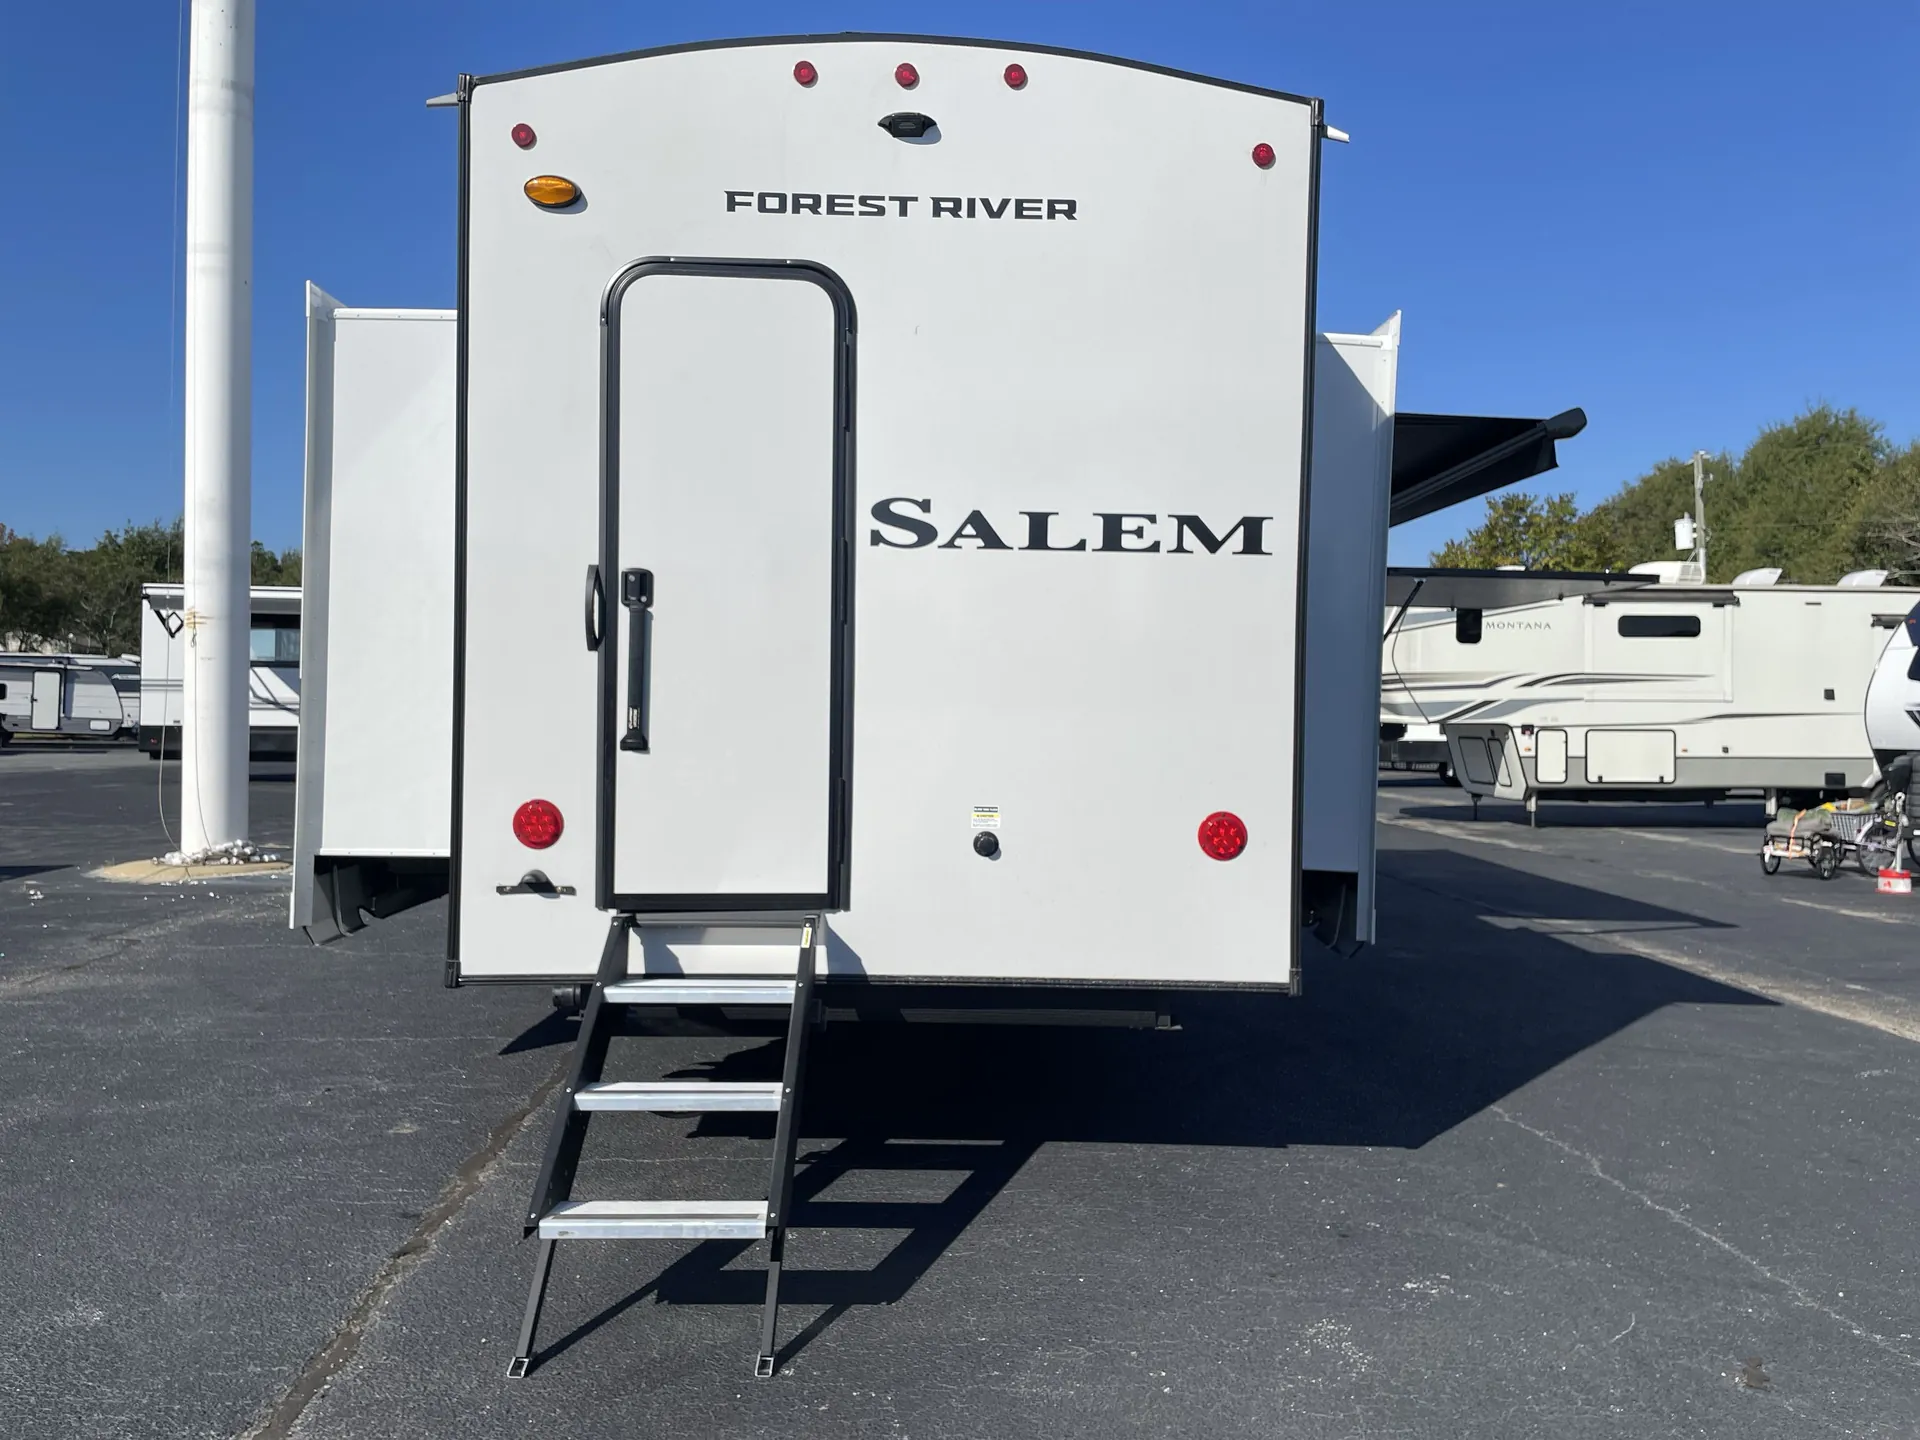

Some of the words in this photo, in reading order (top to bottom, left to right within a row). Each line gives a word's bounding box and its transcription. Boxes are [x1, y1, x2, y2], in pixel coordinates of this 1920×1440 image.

[724, 191, 918, 218] FOREST
[930, 197, 1078, 221] RIVER
[871, 496, 1274, 556] SALEM
[1485, 621, 1552, 630] MONTANA
